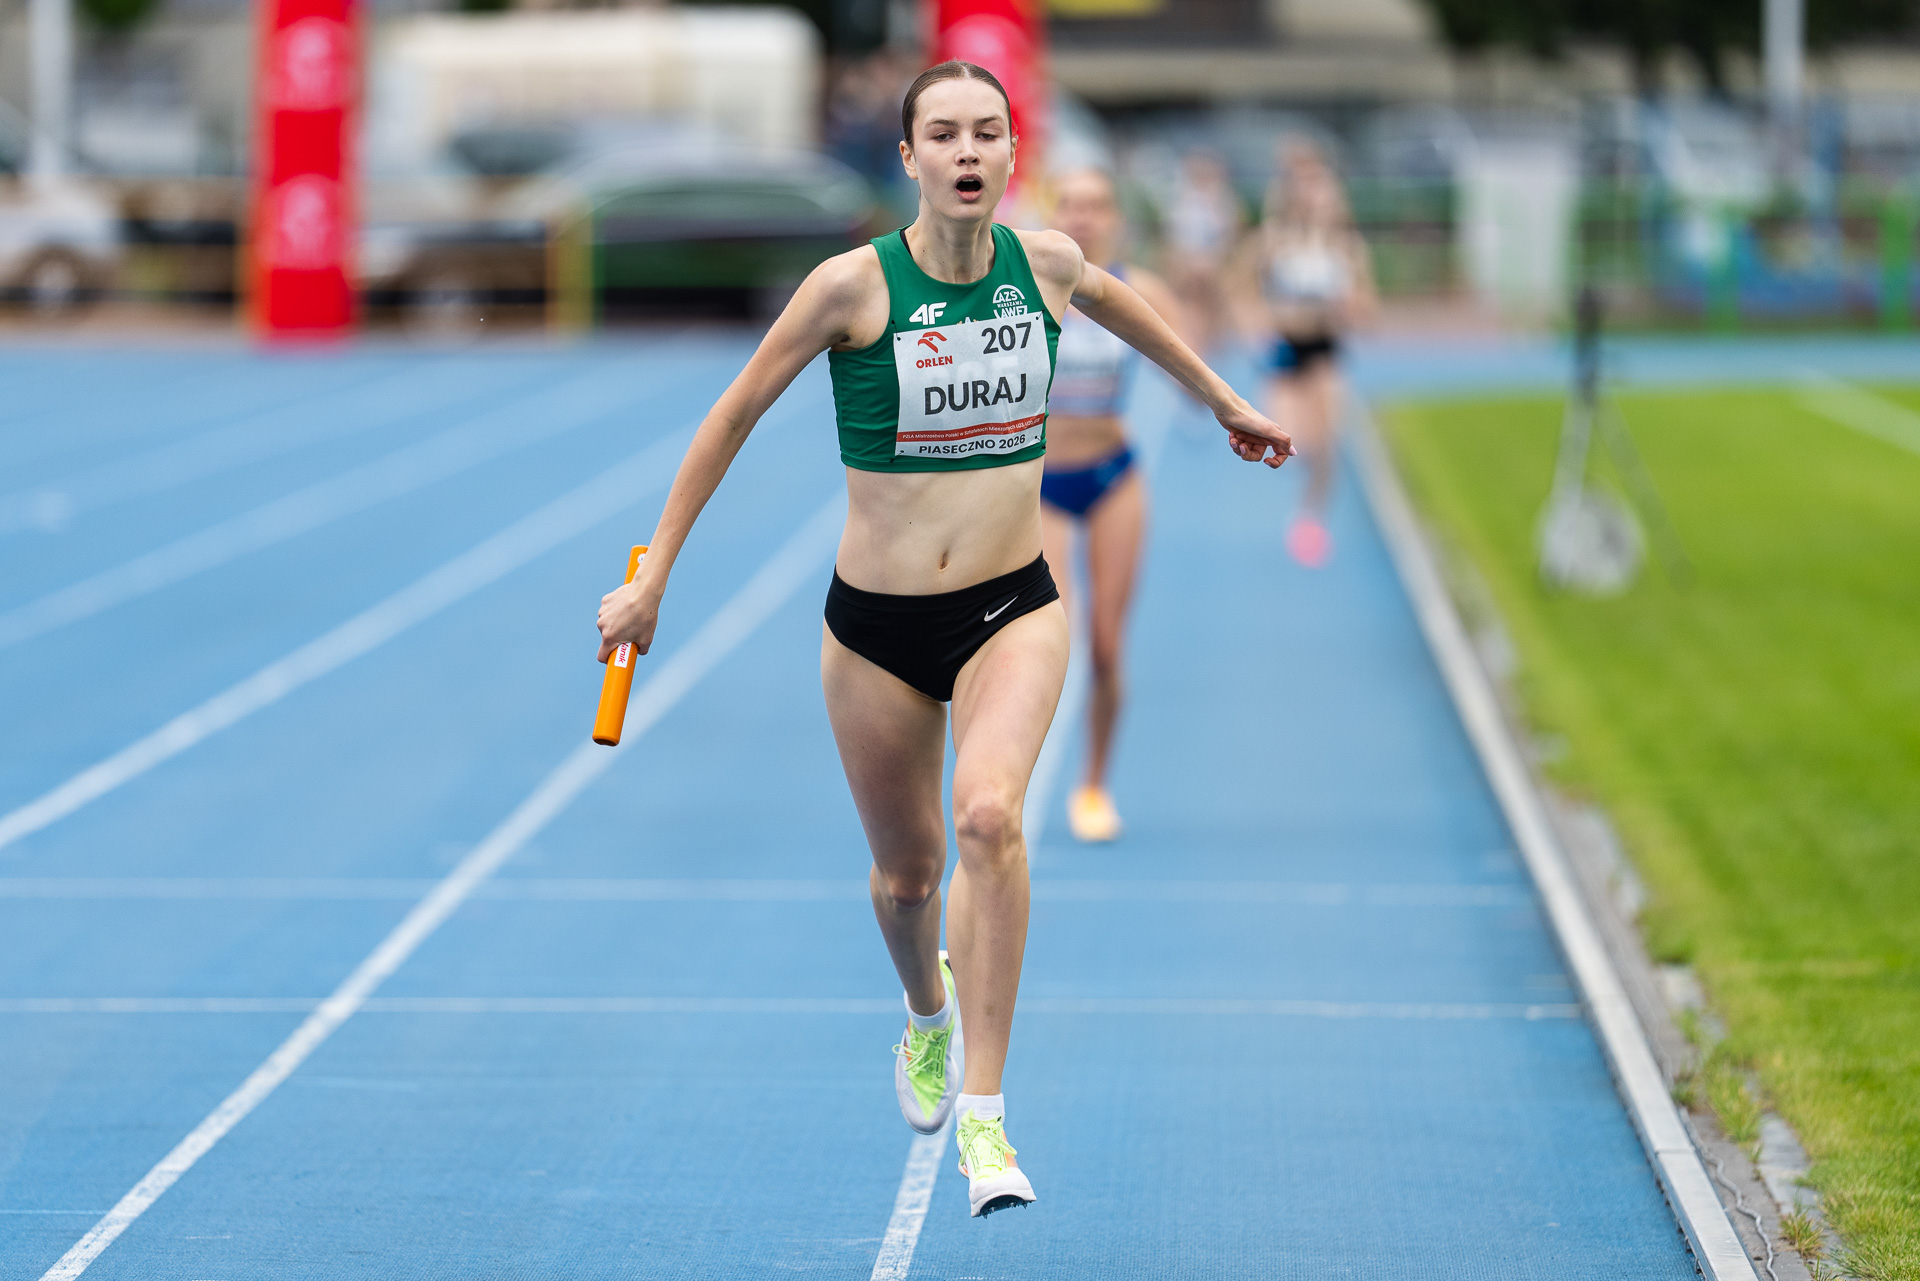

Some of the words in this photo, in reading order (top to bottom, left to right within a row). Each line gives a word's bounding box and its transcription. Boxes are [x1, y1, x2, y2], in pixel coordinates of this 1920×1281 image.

[997, 300, 1023, 308] WARSZAWA
[998, 290, 1018, 302] AZS
[909, 301, 947, 325] 4F
[981, 321, 1032, 355] 207
[916, 355, 953, 369] ORLEN
[924, 372, 1027, 416] DURAJ
[918, 439, 996, 454] PIASECZNO
[999, 434, 1026, 449] 2026
[618, 643, 629, 663] lanik
